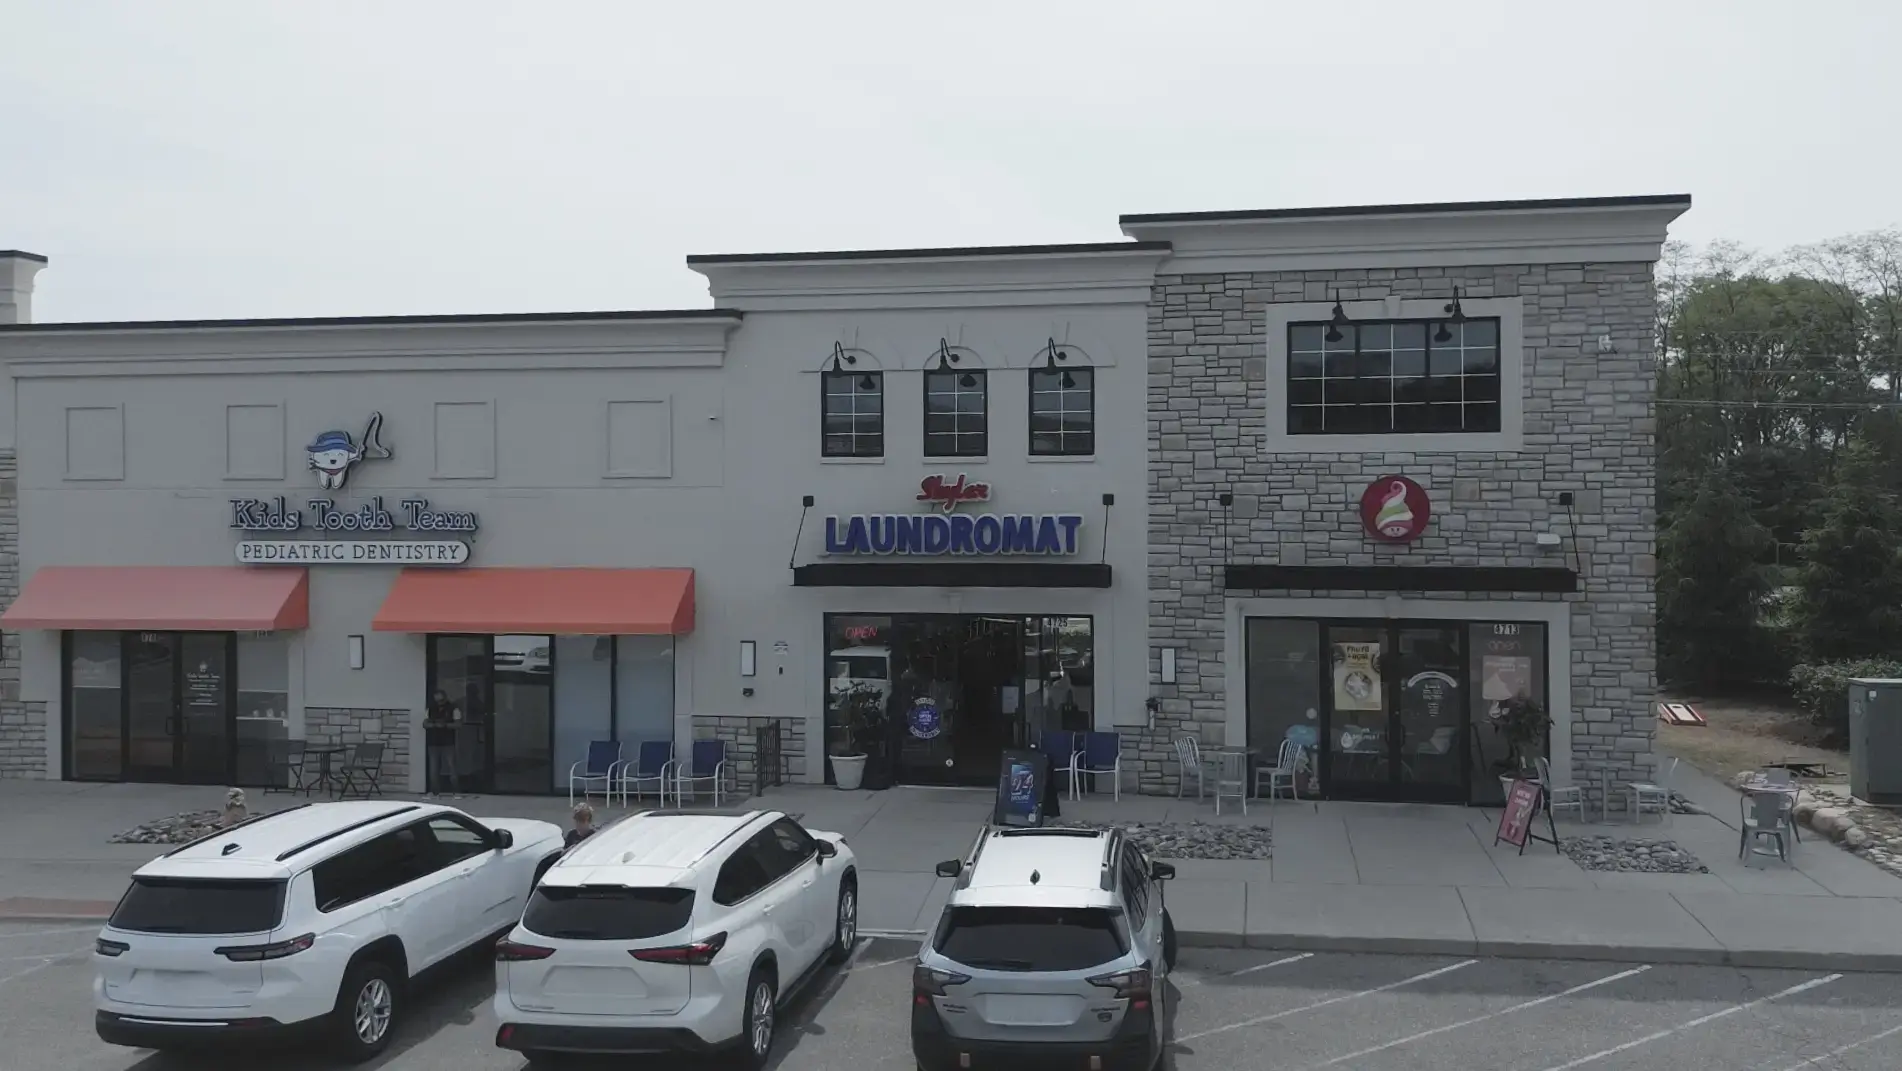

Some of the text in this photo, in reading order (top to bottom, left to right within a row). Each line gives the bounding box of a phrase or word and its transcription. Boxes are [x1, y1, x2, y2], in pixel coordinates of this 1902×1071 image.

[229, 497, 476, 530] Kids Tooth Team
[825, 515, 1083, 555] LAUNDROMAT
[242, 544, 460, 560] PEDIATRIC DENTISTRY
[845, 626, 879, 639] OPEN
[1494, 624, 1520, 635] 4713
